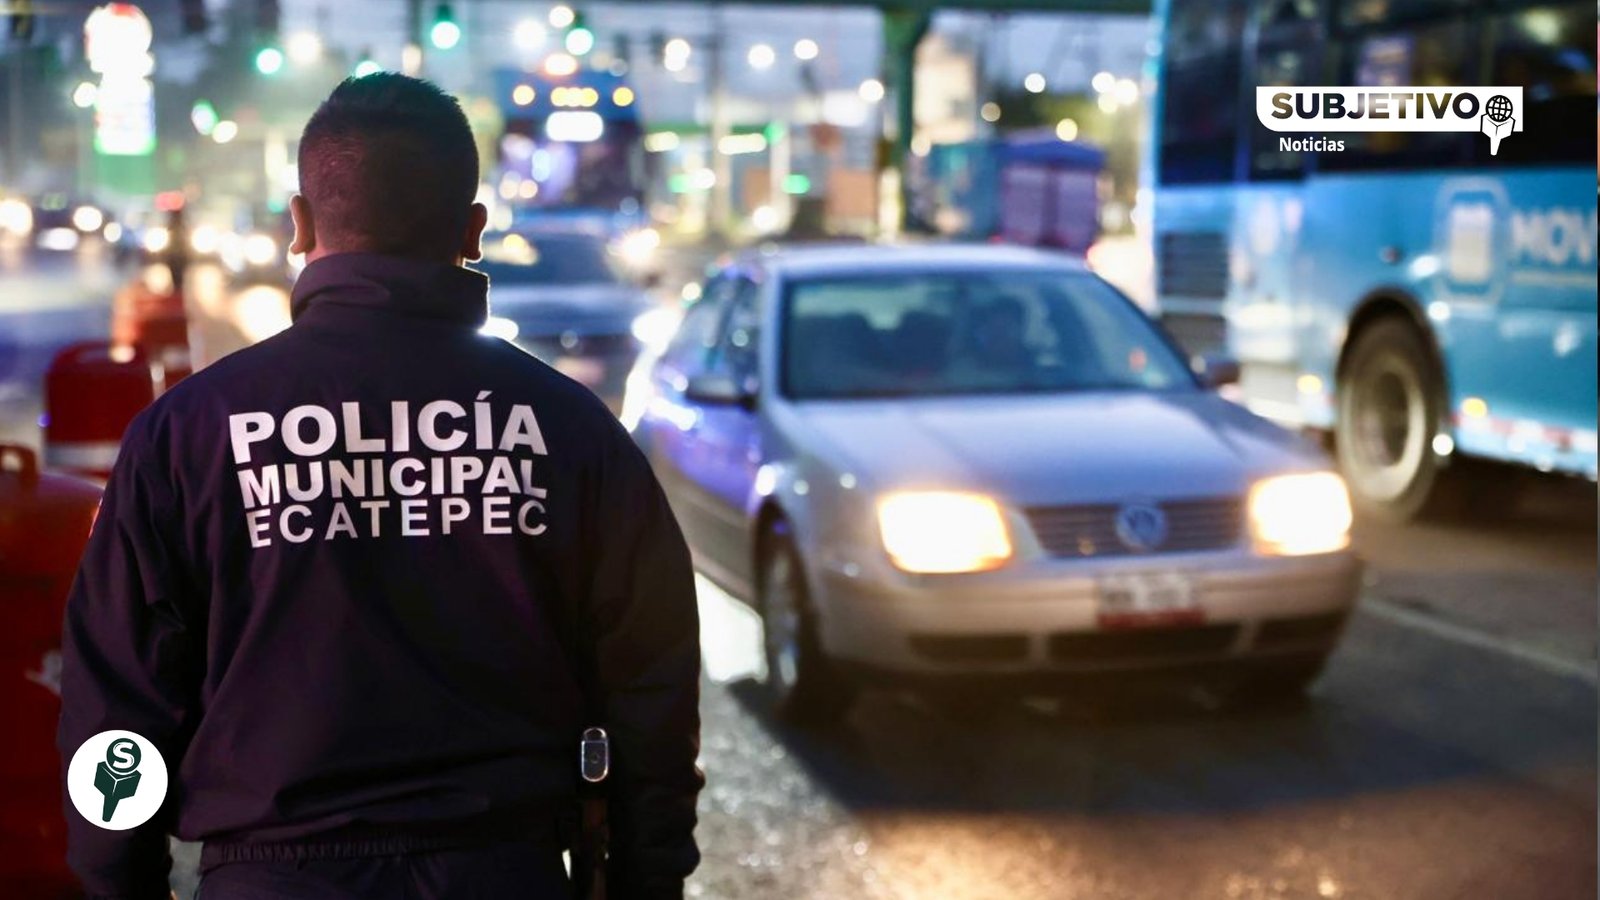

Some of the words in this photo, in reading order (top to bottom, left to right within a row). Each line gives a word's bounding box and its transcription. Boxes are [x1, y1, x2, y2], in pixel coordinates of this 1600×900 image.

[229, 390, 548, 465] POLICÍA
[237, 456, 548, 509] MUNICIPAL
[246, 496, 548, 549] ECATEPEC
